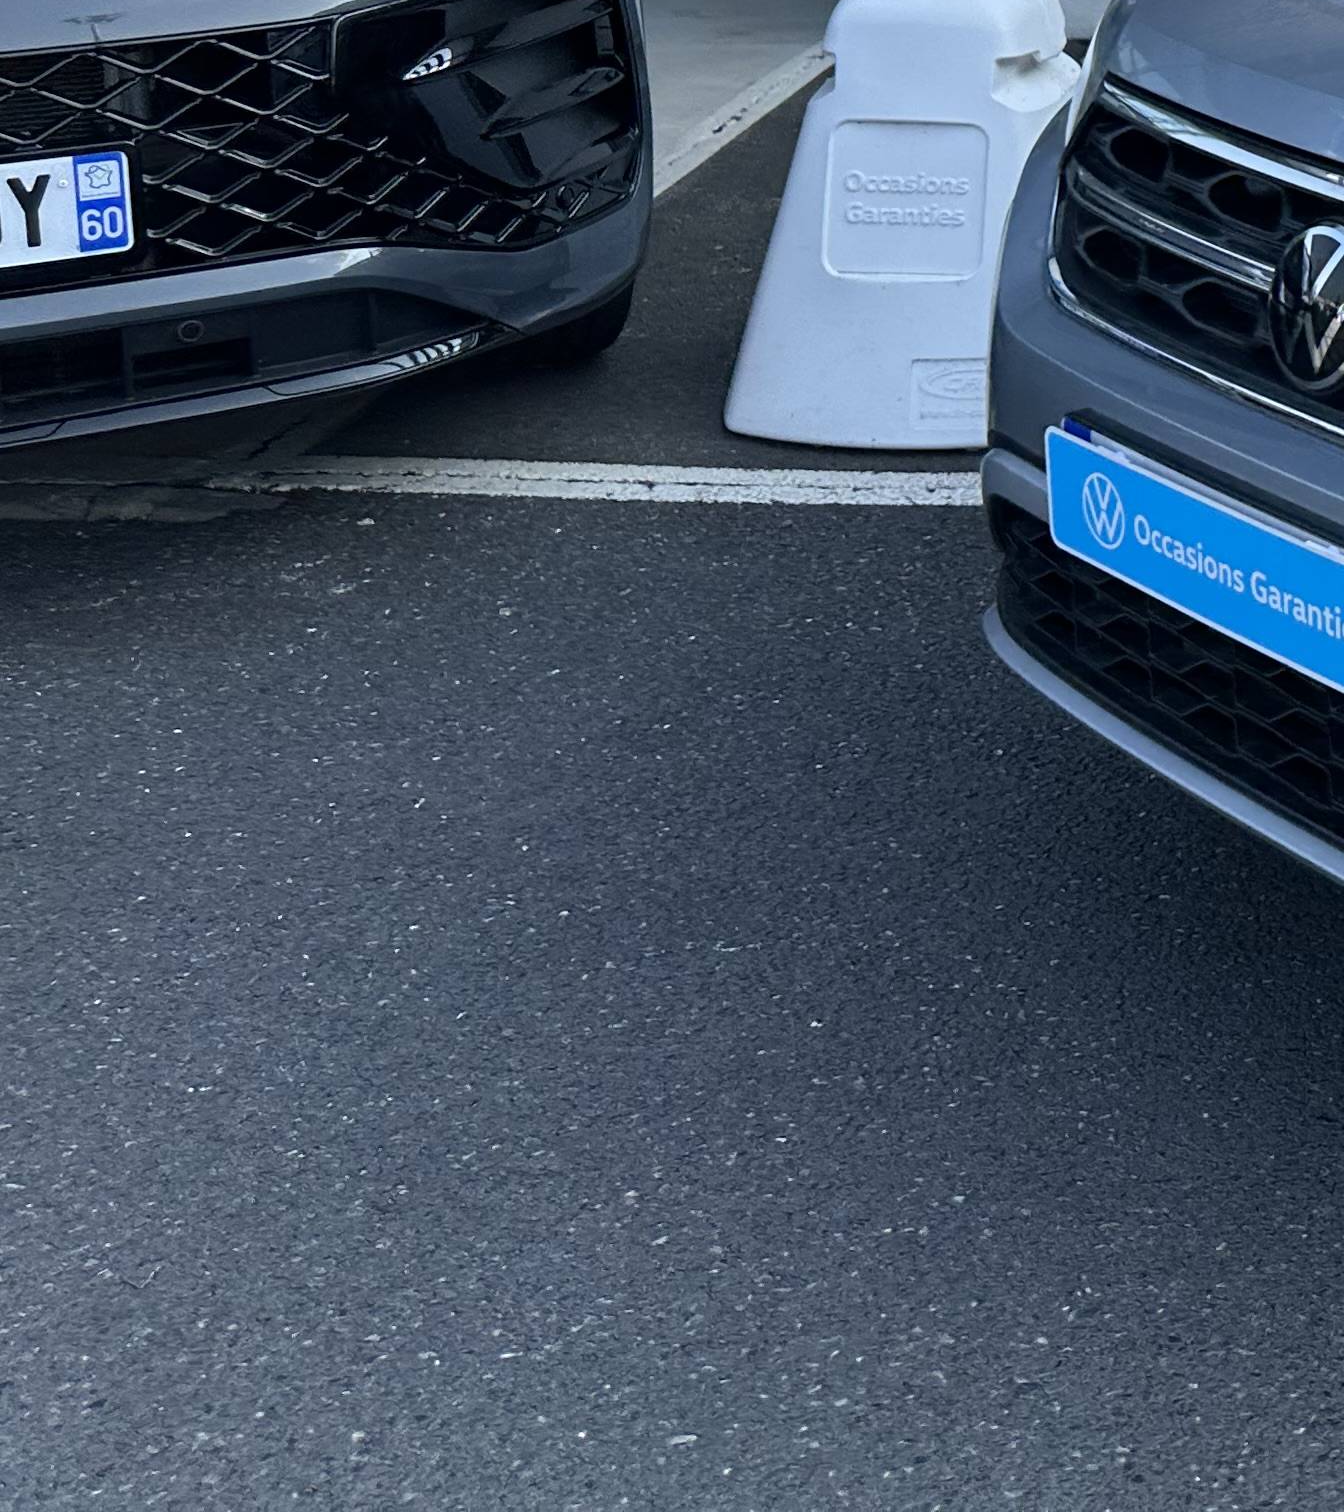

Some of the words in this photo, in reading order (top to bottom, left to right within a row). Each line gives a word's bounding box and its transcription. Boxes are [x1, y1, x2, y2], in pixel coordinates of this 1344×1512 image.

[843, 169, 970, 197] Occasions
[81, 205, 124, 241] 60
[843, 200, 967, 228] Garanties
[1133, 513, 1245, 595] Occasions
